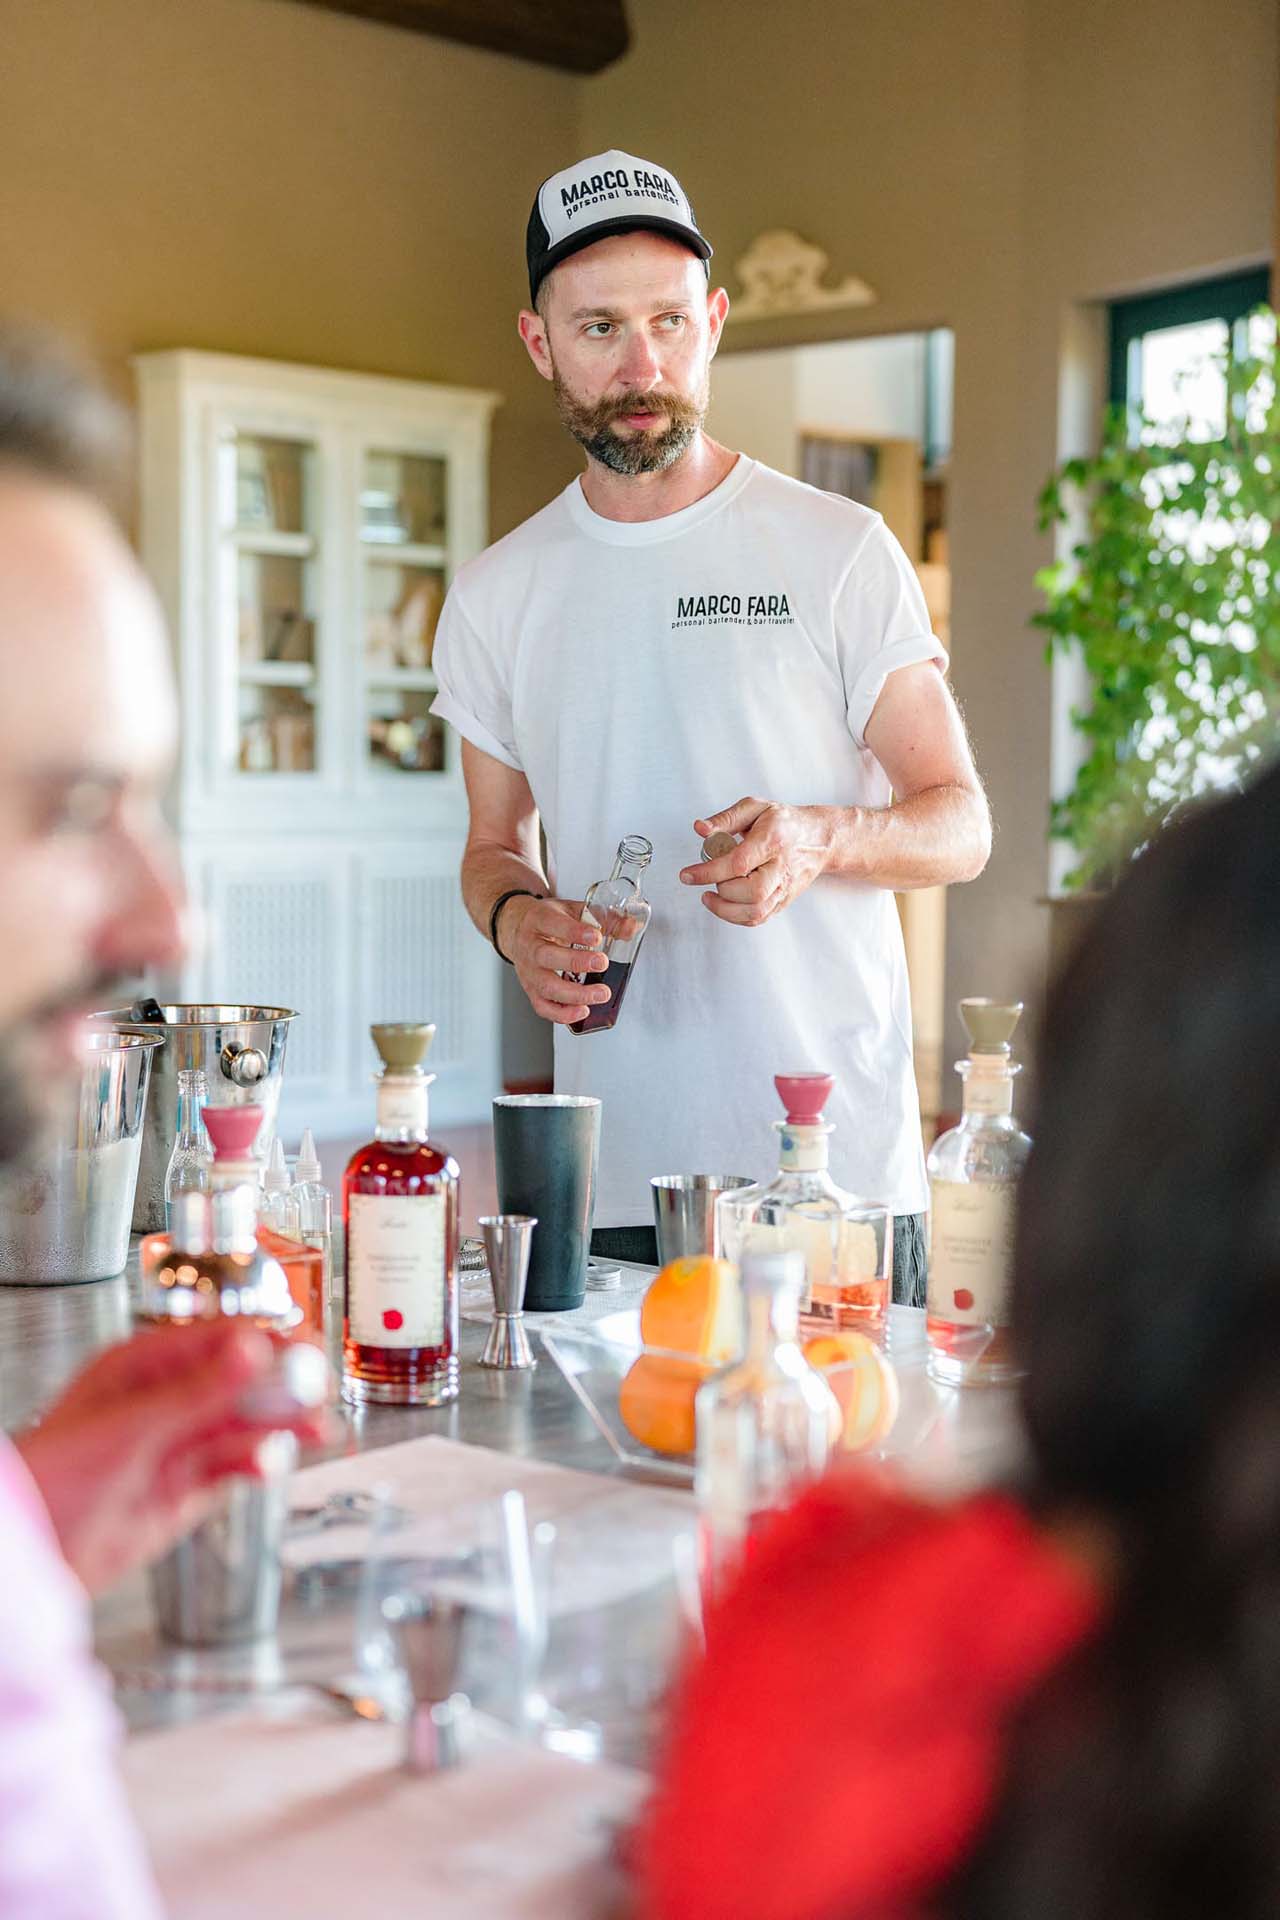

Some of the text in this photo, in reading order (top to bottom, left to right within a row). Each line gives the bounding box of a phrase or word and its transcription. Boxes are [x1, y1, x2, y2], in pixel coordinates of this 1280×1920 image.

[561, 169, 676, 206] MARCO FARA
[566, 189, 679, 219] personal bartender
[677, 594, 790, 618] MARCO FARA
[672, 619, 705, 629] personal
[708, 616, 745, 625] bartender
